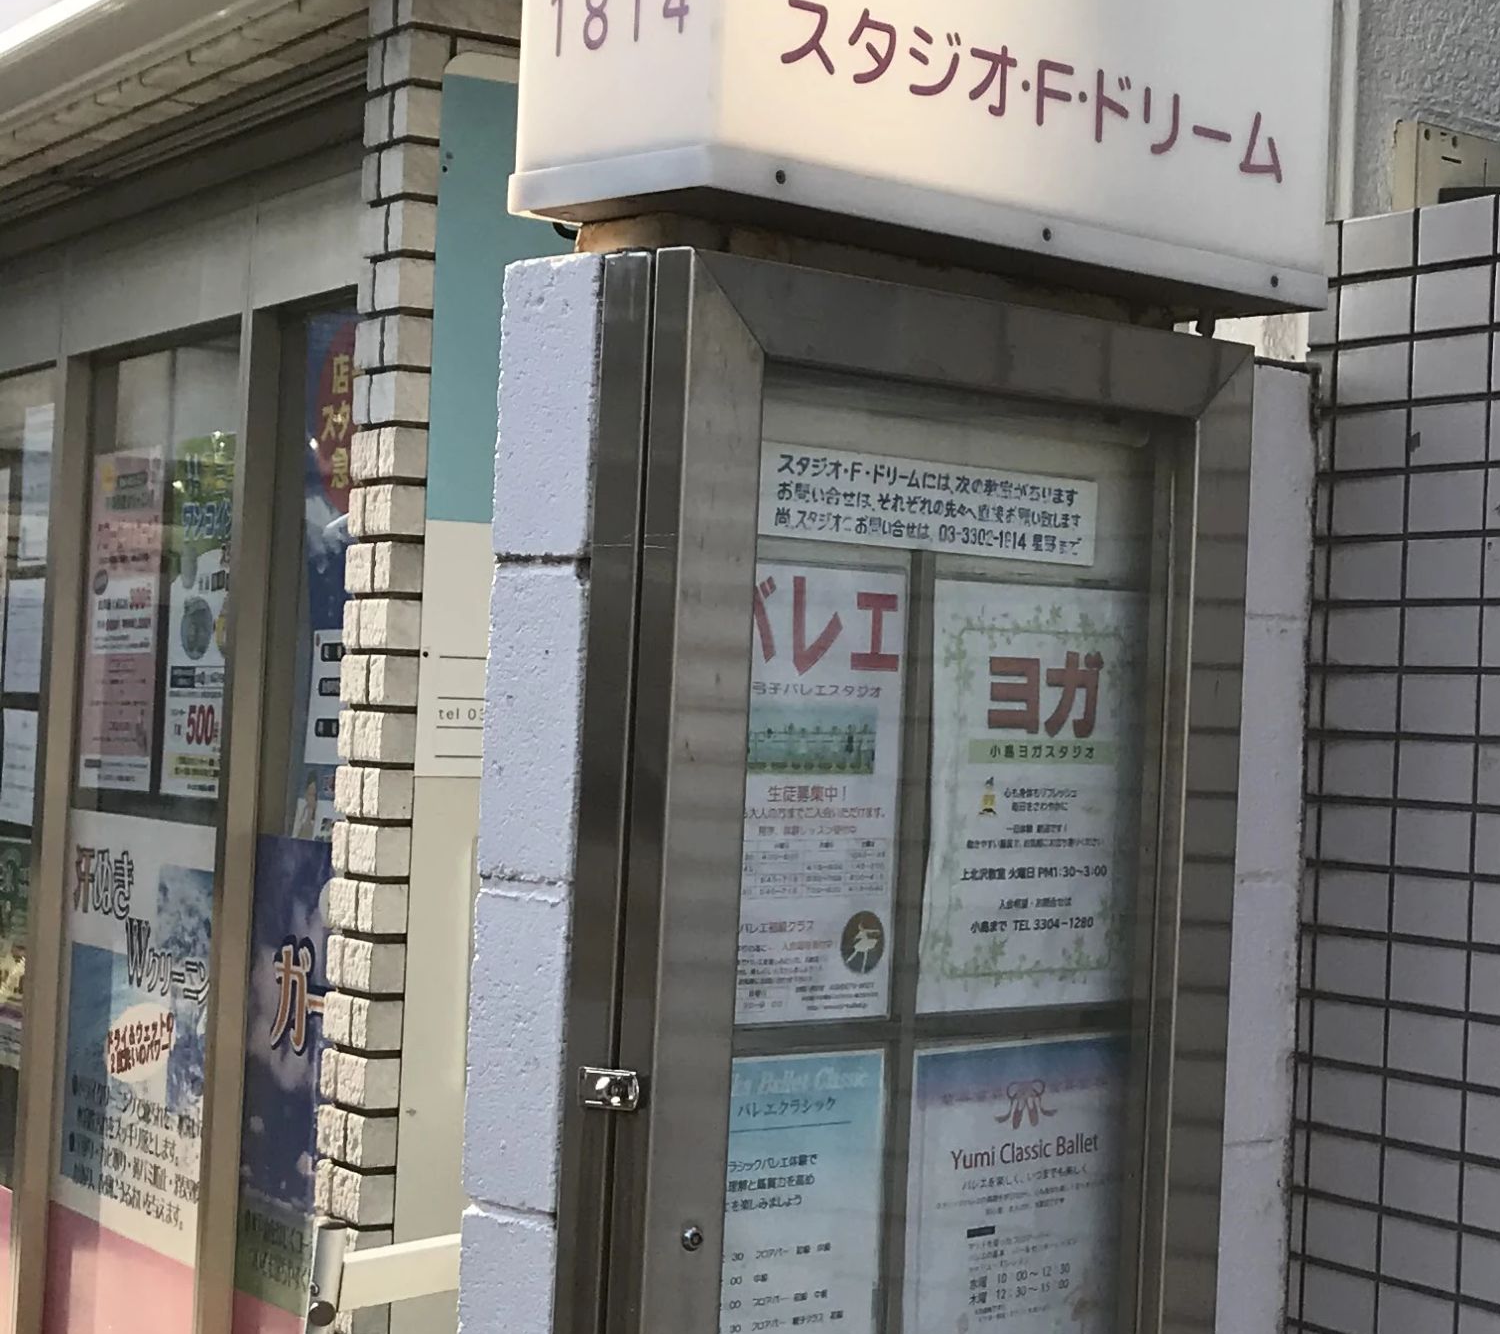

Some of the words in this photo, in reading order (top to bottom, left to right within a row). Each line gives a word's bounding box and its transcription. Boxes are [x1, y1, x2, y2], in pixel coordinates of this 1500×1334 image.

[987, 651, 1104, 739] ヨガ
[186, 703, 215, 746] 500
[438, 706, 460, 721] tel
[989, 744, 1096, 760] 小島ヨガスタジオ
[1013, 919, 1031, 931] TEL
[737, 1096, 837, 1118] バレエクラシック
[951, 1145, 995, 1170] Yumi
[999, 1138, 1052, 1164] Classic
[1056, 1133, 1099, 1157] Ballet
